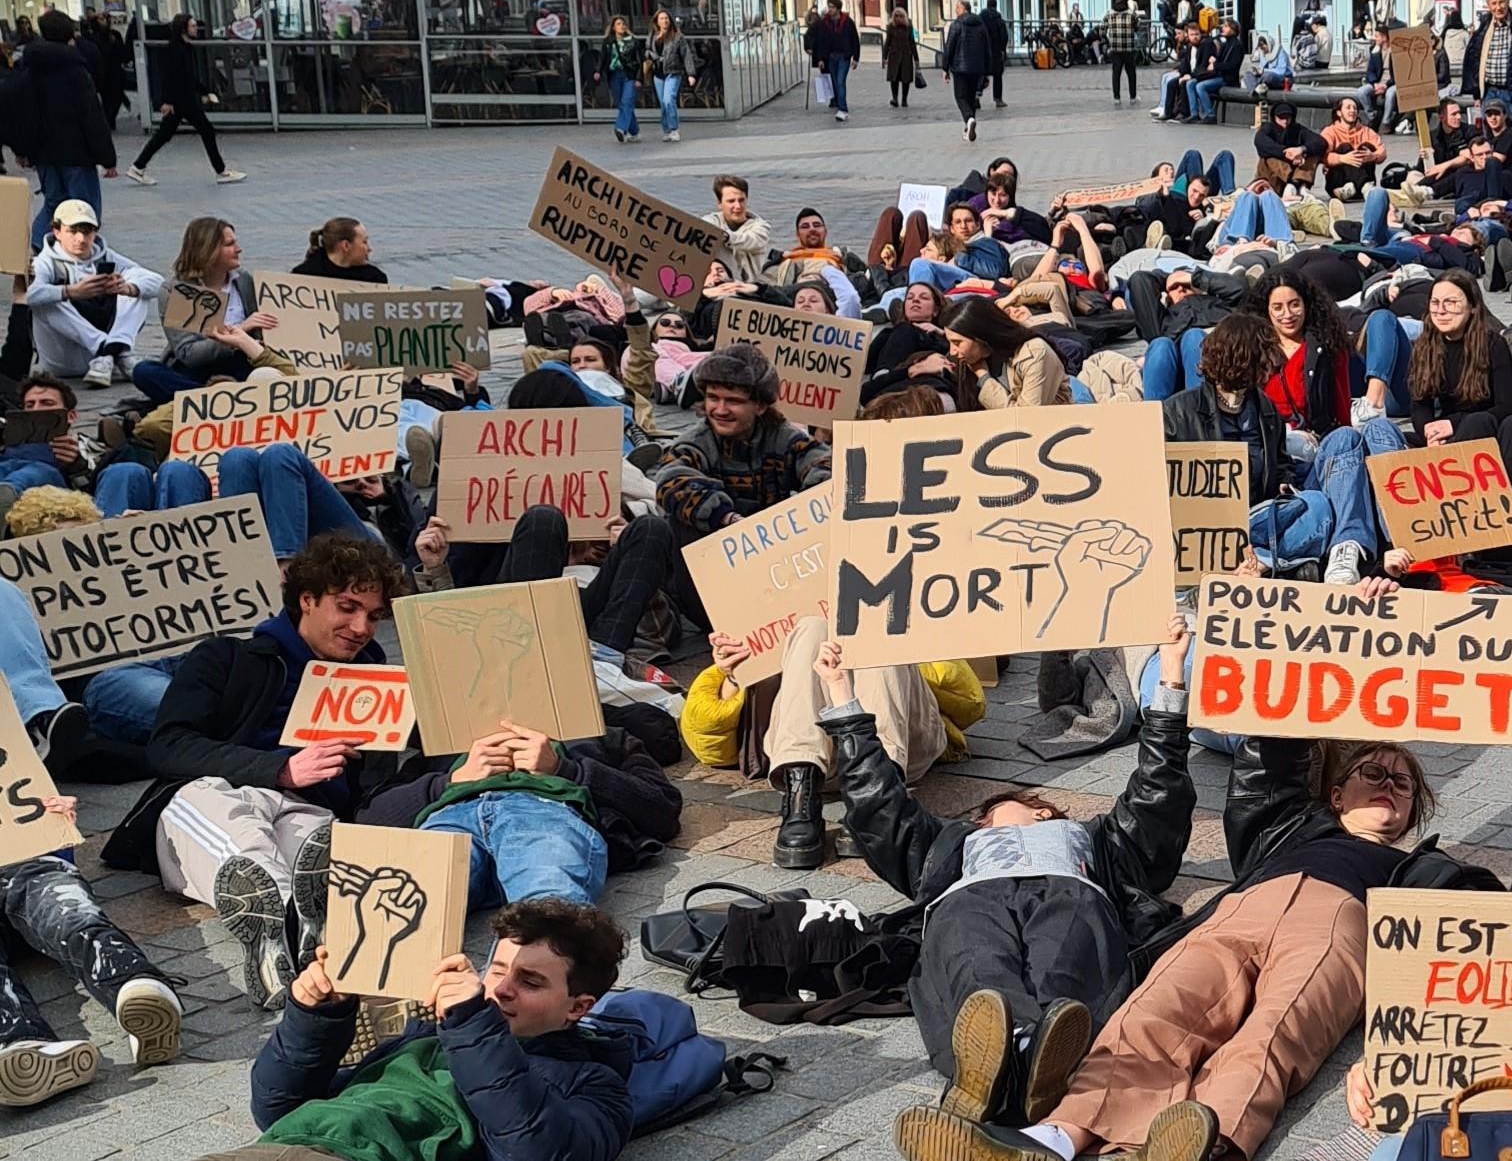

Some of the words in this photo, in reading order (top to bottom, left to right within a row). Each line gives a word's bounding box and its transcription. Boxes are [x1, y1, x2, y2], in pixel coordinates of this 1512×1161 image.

[557, 160, 714, 255] ARCHITECTURE
[563, 192, 582, 209] AU
[639, 236, 662, 253] DE
[668, 250, 687, 265] LA
[541, 206, 649, 280] RUPTURE
[343, 302, 375, 321] NE
[384, 301, 464, 320] RESTEZ
[727, 308, 743, 330] LE
[747, 309, 812, 342] BUDGET
[812, 324, 866, 351] COULE
[343, 340, 374, 358] PAS
[374, 319, 466, 369] PLANTÉS
[465, 327, 489, 353] LÀ
[775, 345, 852, 379] MAISONS
[181, 386, 257, 423] NOS
[269, 371, 402, 413] BUDGETS
[173, 408, 328, 455] COULENT
[334, 401, 399, 432] VOS
[477, 418, 578, 457] ARCHI
[467, 468, 611, 524] PRÉCAIRES
[843, 426, 1103, 521] LESS
[1166, 459, 1243, 501] TUDIER
[0, 539, 52, 582] ON
[62, 531, 128, 572] NE
[130, 507, 260, 557] COMPTE
[721, 508, 808, 569] PARCE
[886, 522, 941, 554] IS
[31, 576, 107, 617] PAS
[122, 550, 229, 598] ÊTRE
[769, 542, 825, 590] C'EST
[836, 552, 1051, 637] MORT
[1208, 581, 1303, 613] POUR
[1325, 593, 1399, 620] UNE
[1203, 610, 1437, 658] ÉLÉVATION
[310, 685, 405, 725] NON
[1372, 913, 1422, 952] ON
[1436, 916, 1509, 956] EST
[1368, 1004, 1502, 1047] ARRETEZ
[1372, 1051, 1502, 1091] FOUTRE
